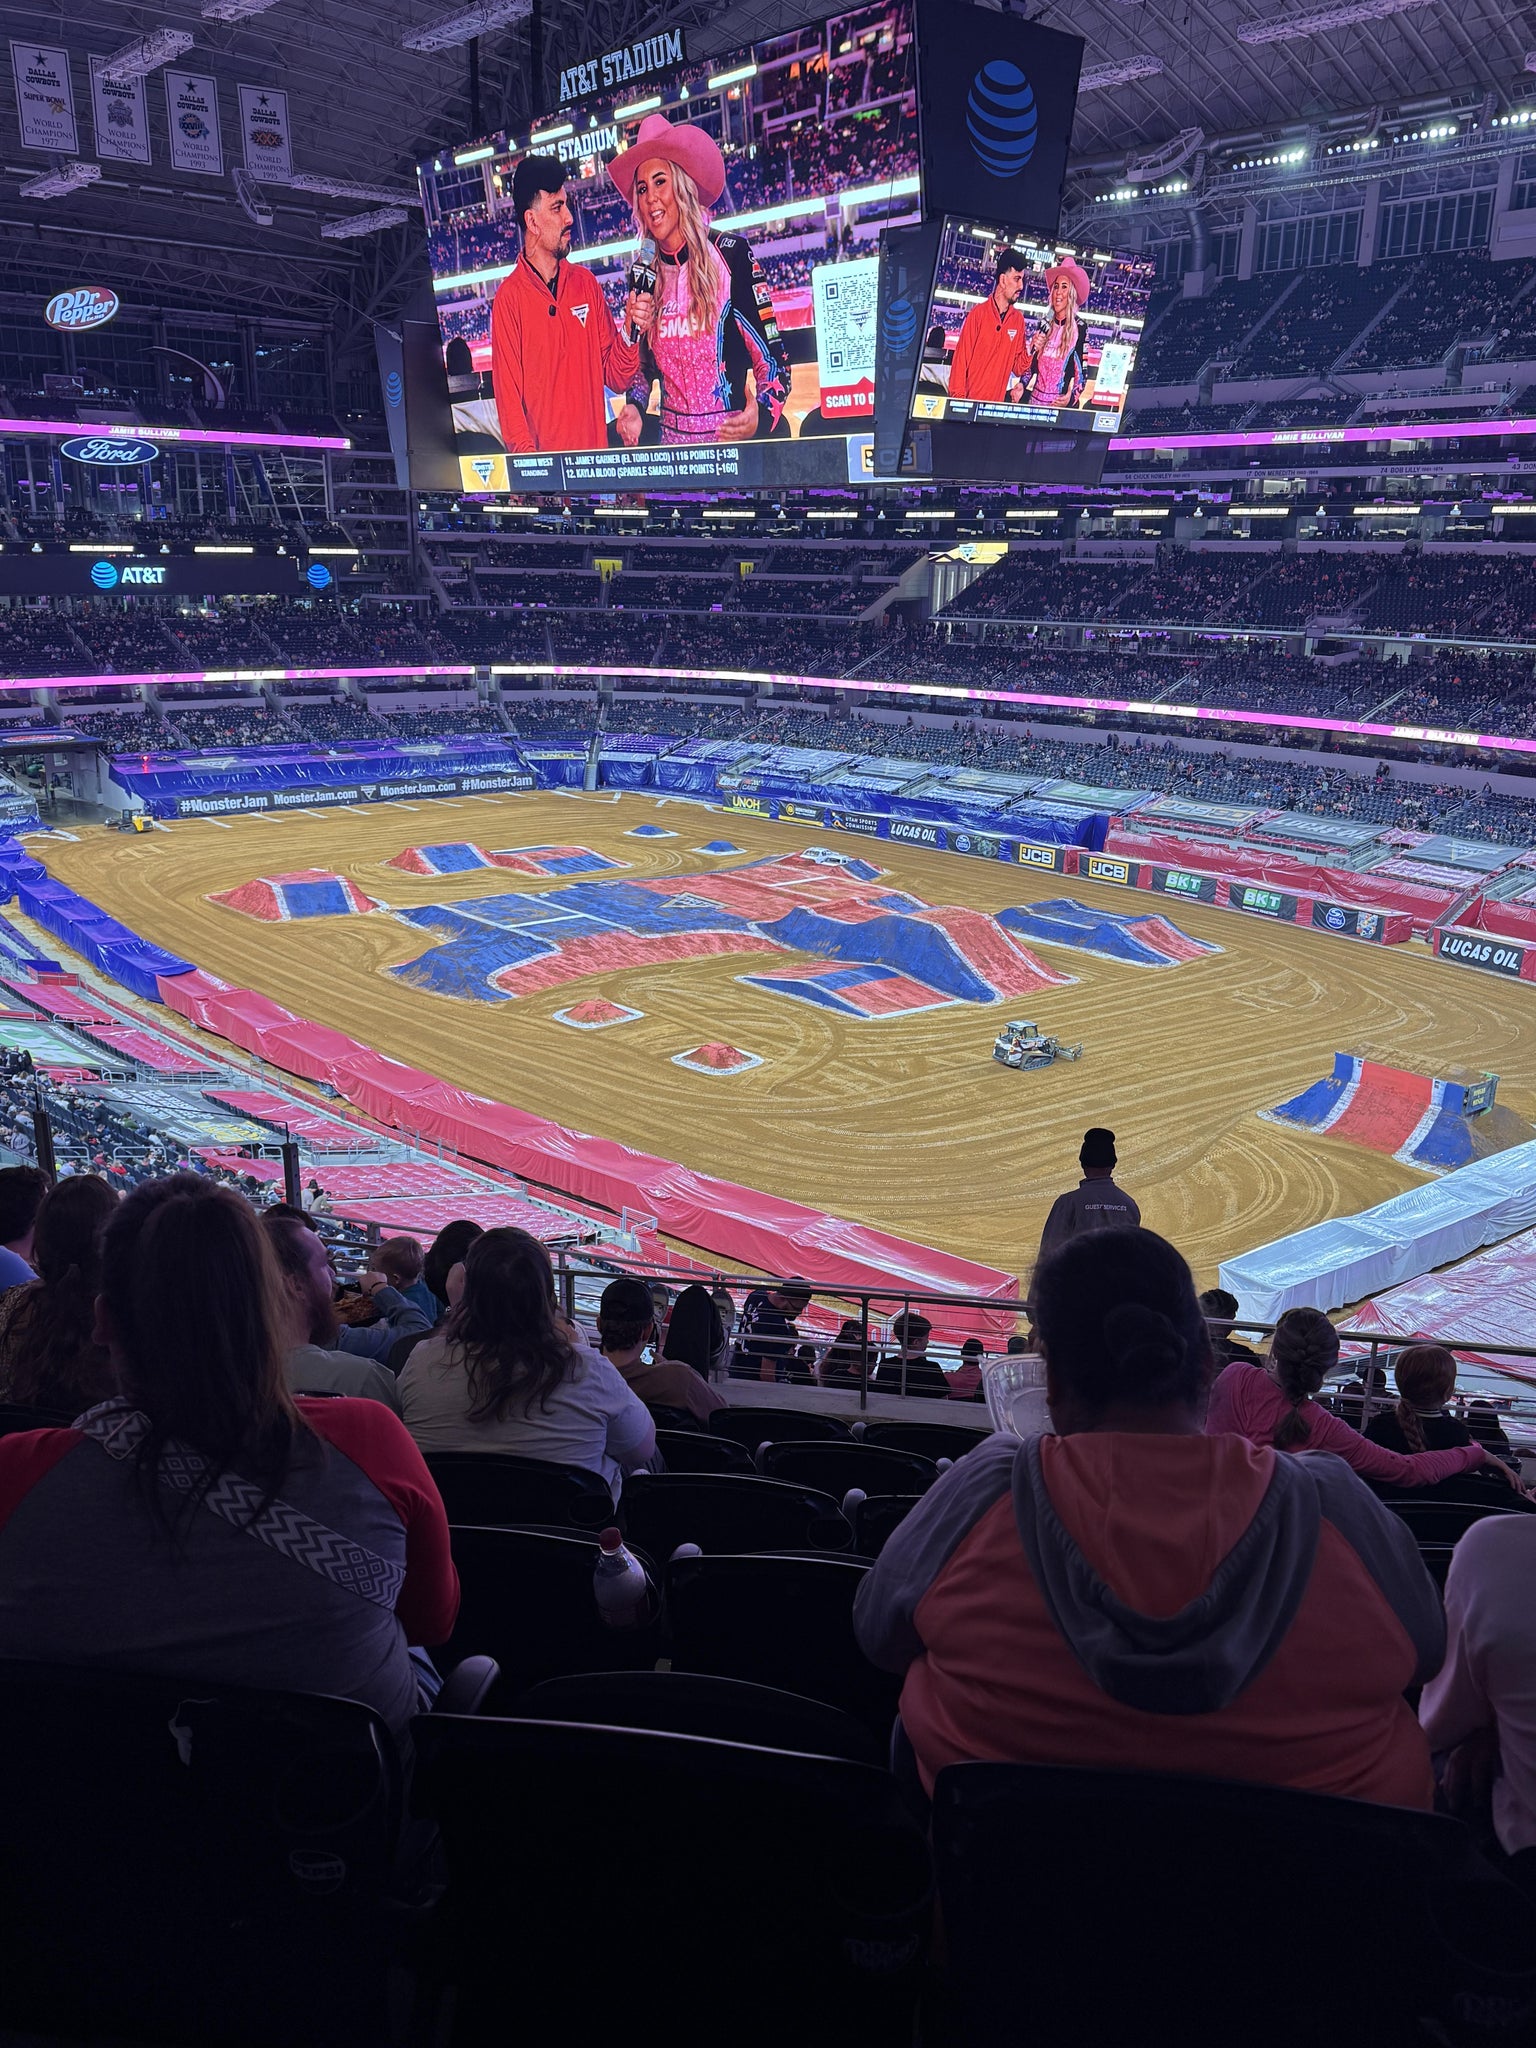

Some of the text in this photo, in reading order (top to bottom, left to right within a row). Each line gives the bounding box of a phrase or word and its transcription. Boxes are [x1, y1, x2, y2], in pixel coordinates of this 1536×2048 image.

[560, 28, 684, 102] AT&T STADIUM
[28, 67, 57, 79] DALLAS
[25, 76, 61, 87] COWBOYS
[104, 80, 132, 91] DALLAS
[23, 91, 45, 103] SUPER
[102, 88, 136, 100] COWBOYS
[179, 94, 205, 104] DALLAS
[177, 101, 209, 113] COWBOYS
[252, 107, 277, 117] DALLAS
[33, 117, 63, 129] WORLD
[250, 115, 281, 126] COWBOYS
[25, 125, 73, 140] CHAMPIONS
[107, 128, 137, 140] WORLD
[41, 137, 59, 147] 1977
[100, 136, 146, 151] CHAMPIONS
[182, 141, 210, 151] WORLD
[558, 124, 619, 163] STADIUM
[175, 148, 219, 161] CHAMPIONS
[255, 153, 282, 164] WORLD
[190, 160, 206, 169] 1993
[248, 161, 291, 173] CHAMPIONS
[73, 290, 101, 309] Dr
[51, 293, 114, 325] Pepper
[825, 394, 852, 409] SCAN
[853, 392, 866, 406] TO
[108, 427, 180, 438] JAMIE SULLIVAN
[1271, 431, 1345, 442] JAMIE SULLIVAN
[80, 439, 142, 461] Ford
[538, 457, 554, 467] WEST
[565, 457, 575, 466] 11.
[575, 455, 595, 465] JAMEY
[632, 452, 649, 463] TORO
[650, 451, 671, 464] LOCO)
[675, 451, 689, 461] 116
[690, 449, 716, 460] POINTS
[566, 470, 576, 479] 12.
[576, 468, 596, 478] KAYLA
[596, 467, 616, 477] BLOOD
[617, 466, 648, 479] (SPARKLE
[679, 465, 689, 475] 92
[690, 463, 715, 475] POINTS
[716, 462, 738, 476] [-160]
[1267, 469, 1296, 477] MEREDITH
[1380, 466, 1388, 474] 74
[121, 566, 166, 584] AT&T
[180, 775, 533, 813] #MonsterJam MonsterJam.com MonsterJam.com #MonsterJam
[732, 795, 761, 810] UNOH
[845, 816, 878, 826] UTAH SPORTS
[845, 822, 878, 832] COMMISSION
[890, 823, 920, 839] LUCAS
[1022, 847, 1053, 864] JCB
[1092, 861, 1125, 879] JCB
[1166, 871, 1201, 892] BKT
[1244, 889, 1281, 910] BKT
[1441, 936, 1492, 962] LUCAS
[1103, 1204, 1127, 1212] SERVICES
